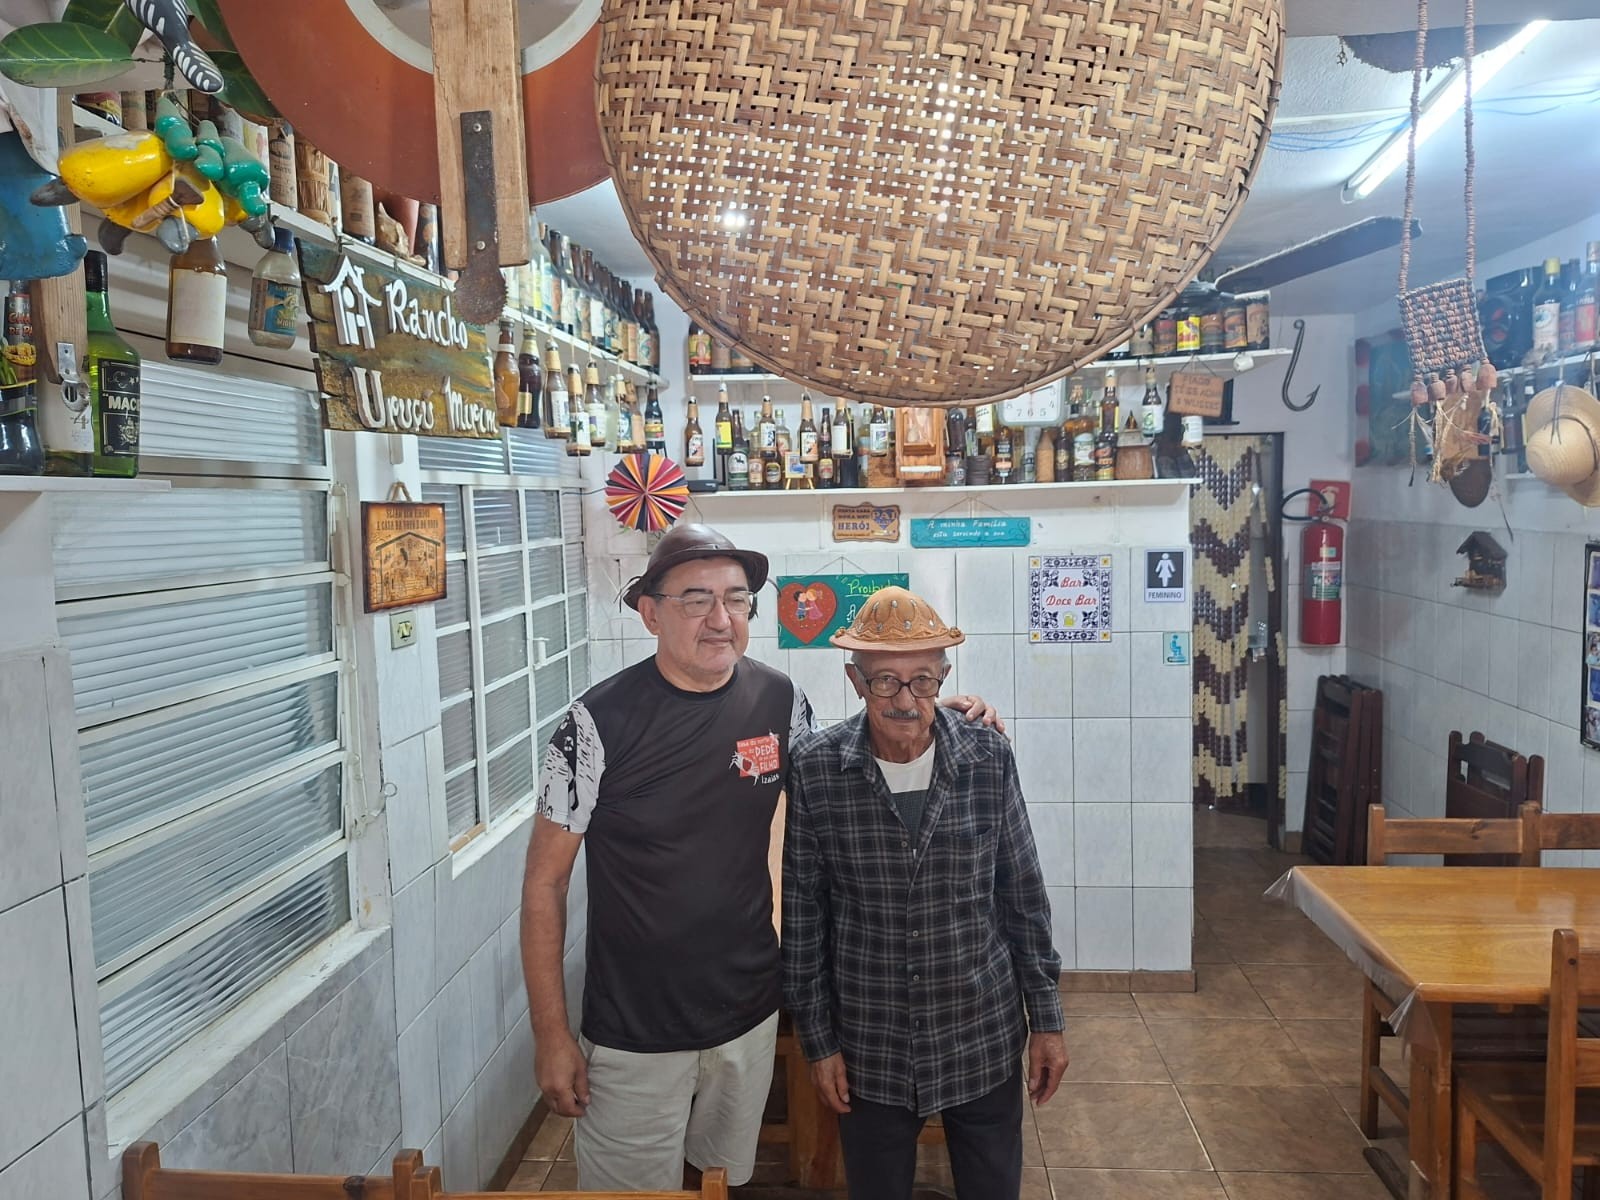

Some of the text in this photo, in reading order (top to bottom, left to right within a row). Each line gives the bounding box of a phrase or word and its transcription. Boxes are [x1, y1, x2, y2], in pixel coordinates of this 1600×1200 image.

[385, 279, 468, 349] Rancho
[872, 511, 898, 520] PAI
[838, 520, 870, 531] HERÓI
[1060, 576, 1083, 588] Bar
[1046, 594, 1097, 606] Doce Bar
[1148, 591, 1182, 600] FEMININO
